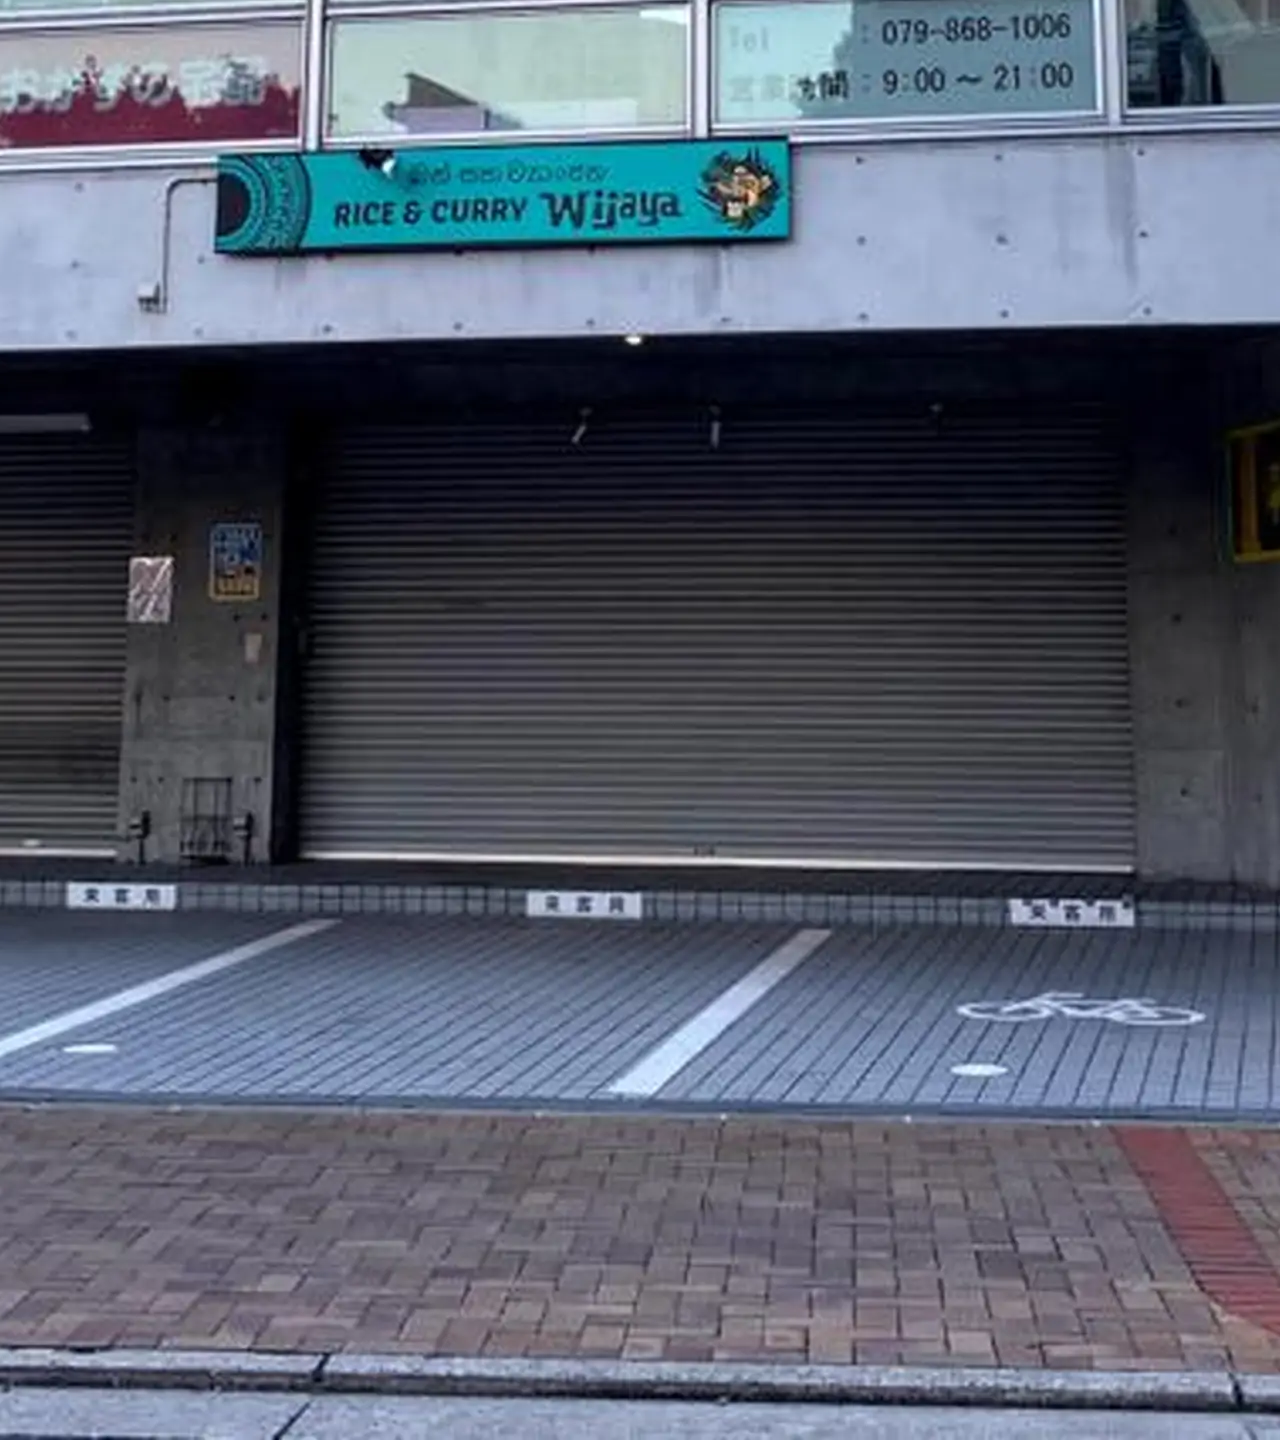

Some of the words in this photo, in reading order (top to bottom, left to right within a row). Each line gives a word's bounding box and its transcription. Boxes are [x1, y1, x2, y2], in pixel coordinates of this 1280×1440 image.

[880, 12, 1072, 46] 079-868-1006
[333, 200, 398, 229] RICE
[402, 199, 421, 226] &
[430, 194, 529, 226] CURRY
[538, 187, 683, 231] Wijaya
